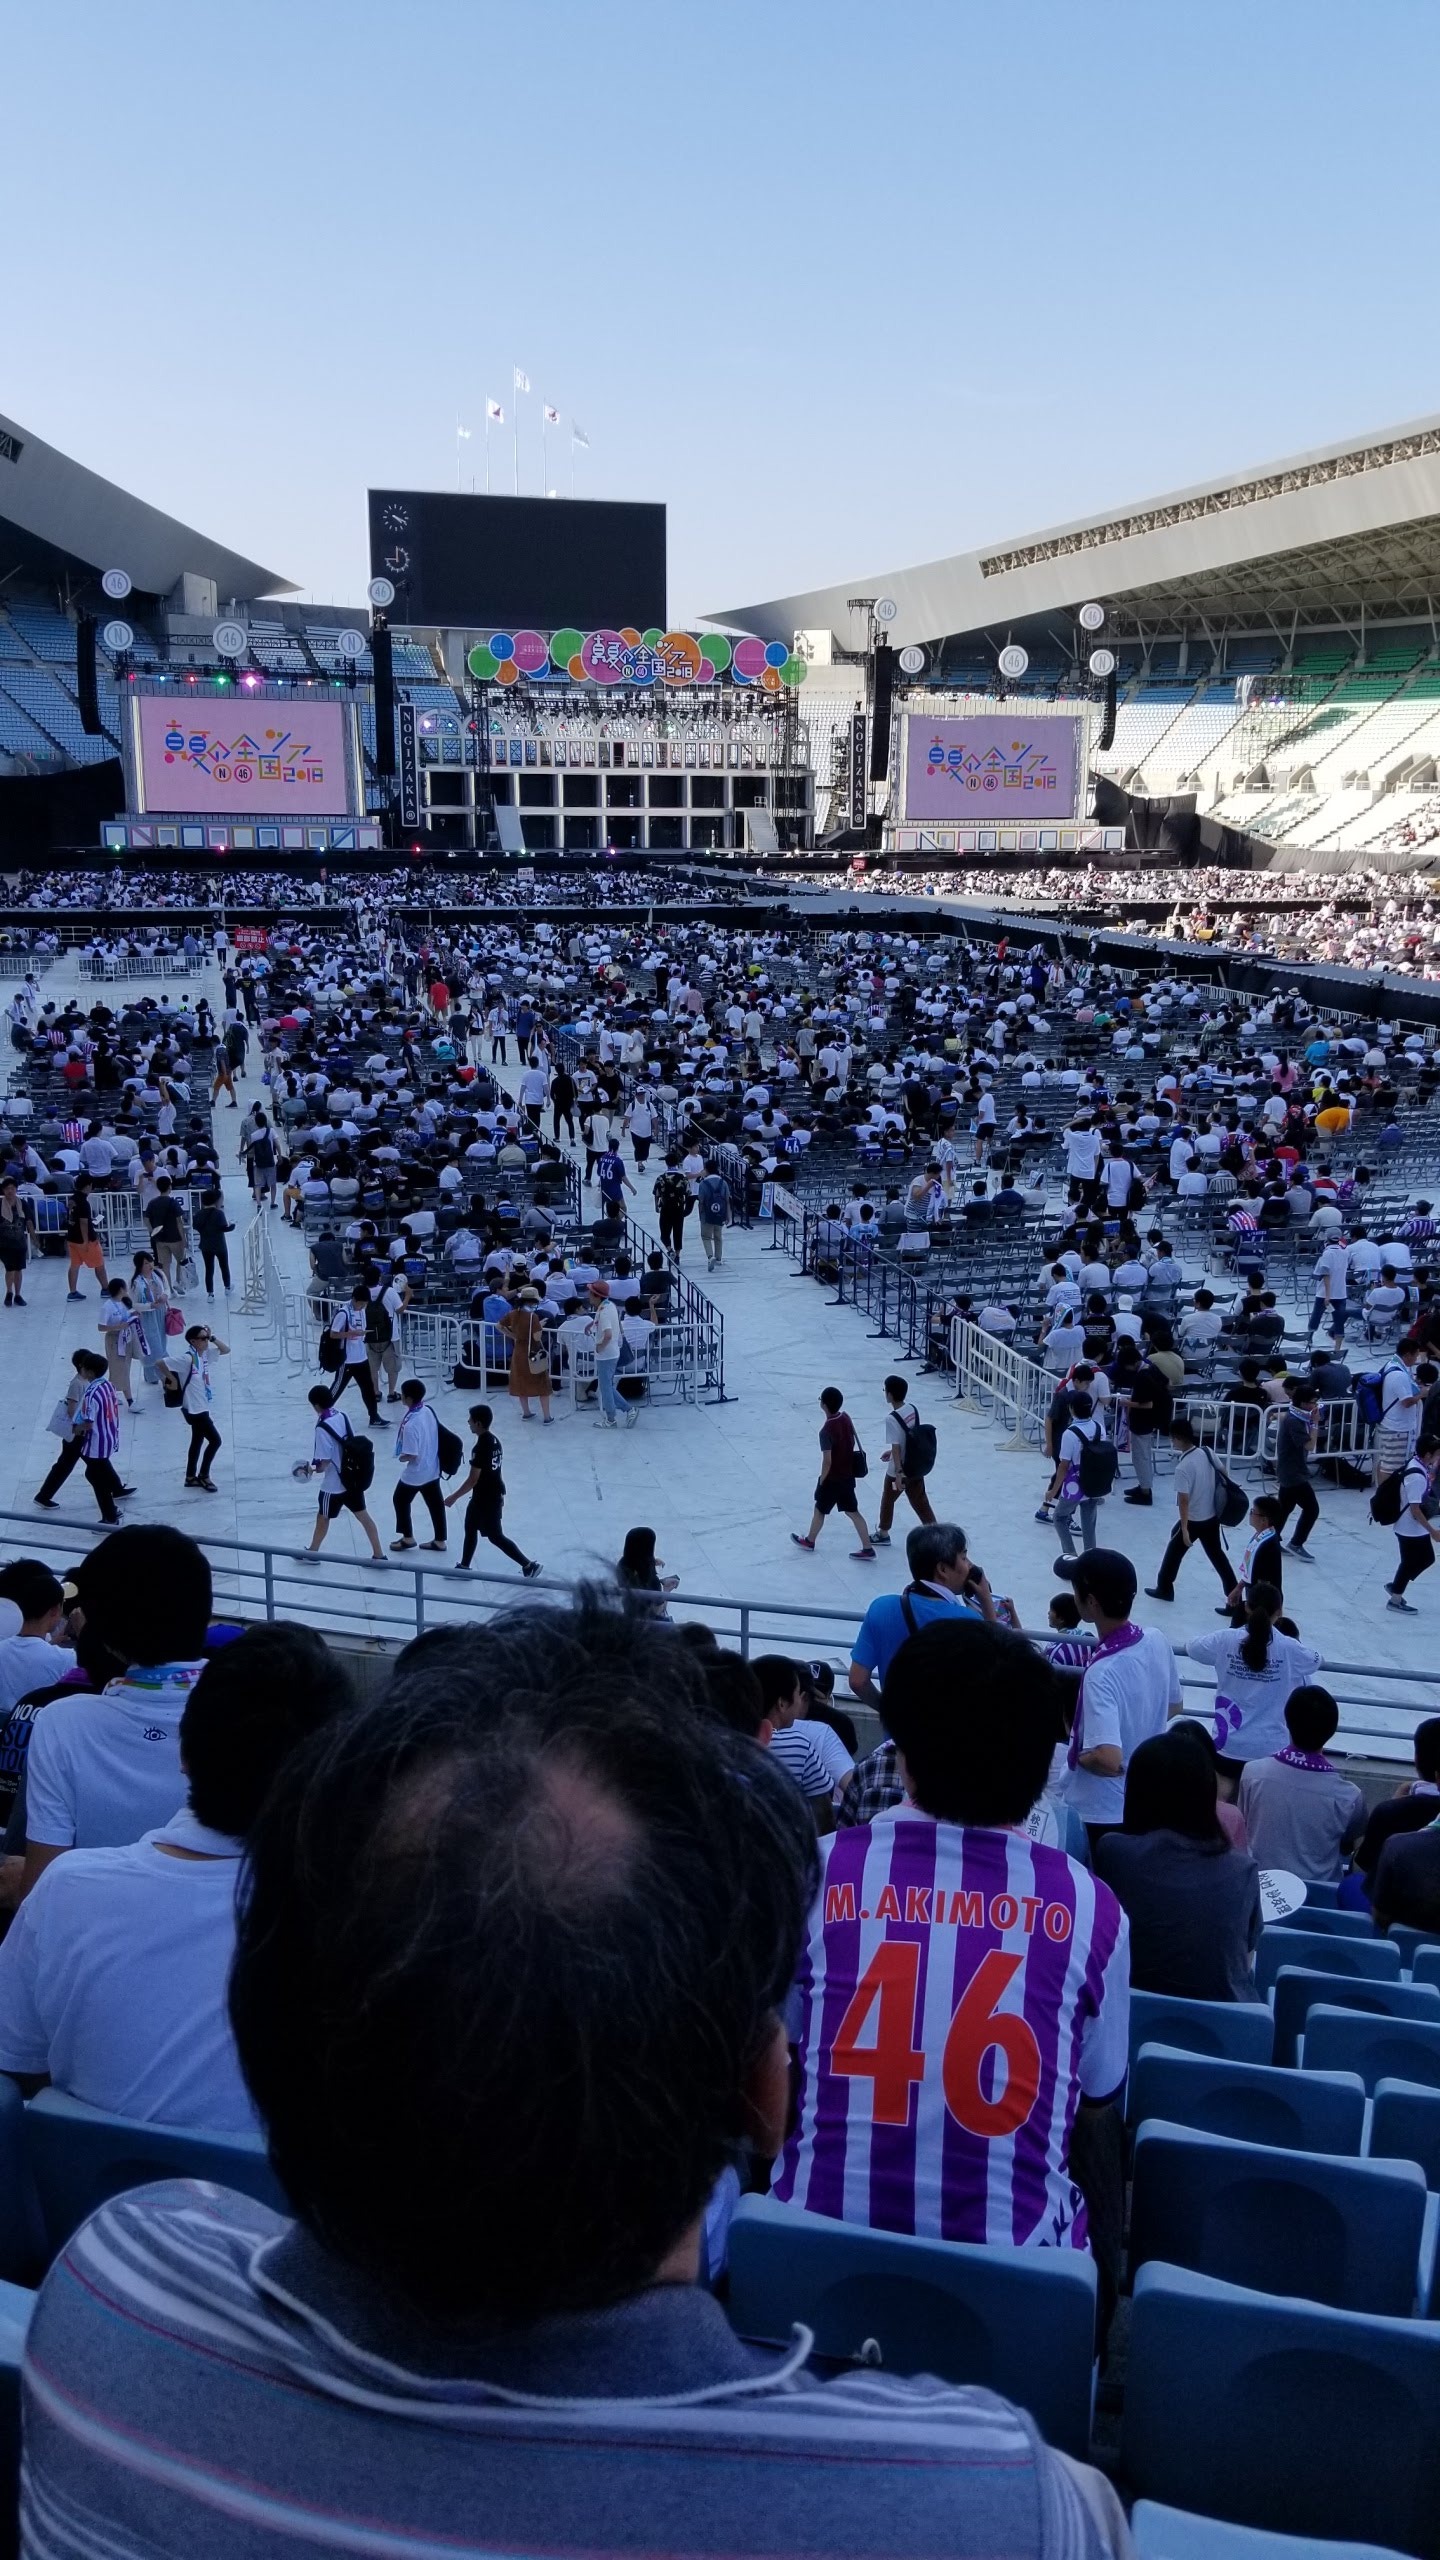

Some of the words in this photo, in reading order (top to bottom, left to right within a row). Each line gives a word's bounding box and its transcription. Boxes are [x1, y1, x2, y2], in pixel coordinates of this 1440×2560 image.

[403, 711, 415, 807] NOGIZAKA
[855, 721, 863, 811] NOGIZAKA
[600, 1162, 613, 1180] 46
[784, 1140, 800, 1154] 46
[825, 1883, 1072, 1942] M.AKIMOTO
[829, 1940, 1042, 2138] 46
